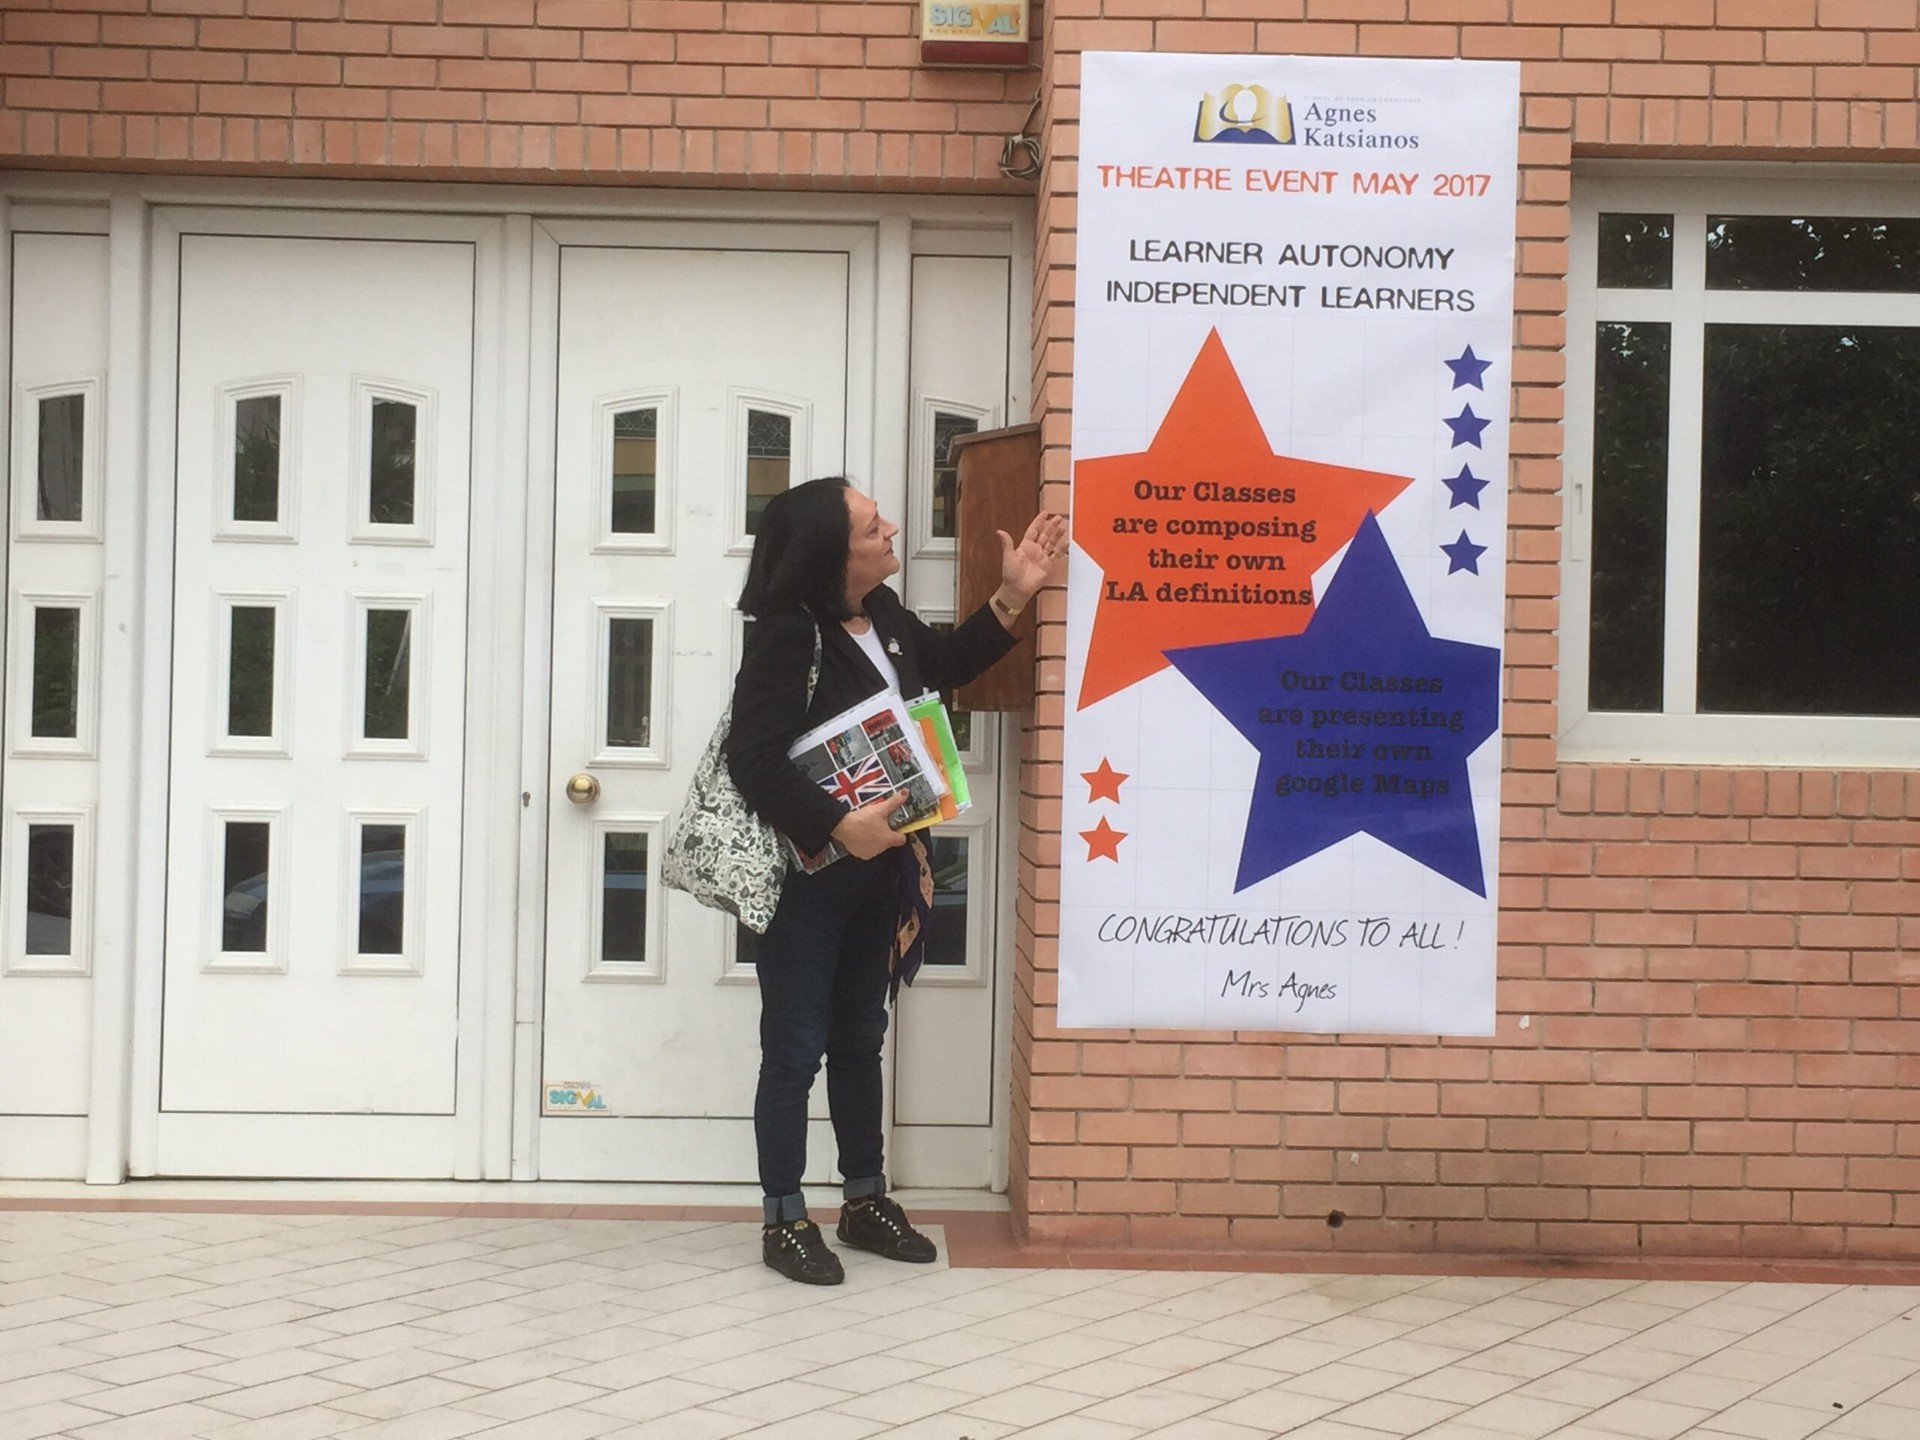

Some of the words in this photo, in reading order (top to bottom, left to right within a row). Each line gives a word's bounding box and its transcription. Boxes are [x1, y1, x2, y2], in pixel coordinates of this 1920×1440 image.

[1304, 102, 1377, 127] Agnes
[1304, 128, 1419, 149] Katsianos
[1097, 165, 1232, 190] THEATRE
[1246, 170, 1338, 195] EVENT
[1353, 172, 1419, 196] MAY
[1433, 173, 1492, 197] 2017
[1130, 239, 1263, 265] LEARNER
[1278, 244, 1455, 270] AUTONOMY
[1106, 280, 1306, 308] INDEPENDENT
[1321, 286, 1475, 312] LEARNERS
[1134, 480, 1186, 501] Our
[1193, 481, 1296, 503] Classes
[1113, 517, 1158, 534] are
[1166, 516, 1317, 543] composing
[1148, 548, 1219, 569] their
[1226, 553, 1286, 571] own
[1105, 581, 1149, 602] LA
[1156, 582, 1313, 606] definitions
[1280, 669, 1333, 691] Our
[1340, 670, 1443, 693] Classes
[1258, 707, 1303, 724] are
[1310, 706, 1465, 733] presenting
[1294, 738, 1365, 759] their
[1372, 743, 1433, 761] own
[1275, 773, 1365, 797] google
[1371, 773, 1449, 798] Maps
[1098, 913, 1349, 948] CONGRATULATIONS
[1358, 916, 1391, 947] TO
[1399, 920, 1446, 950] ALL
[1221, 969, 1268, 999] Mrs
[1277, 971, 1337, 1013] Agnes
